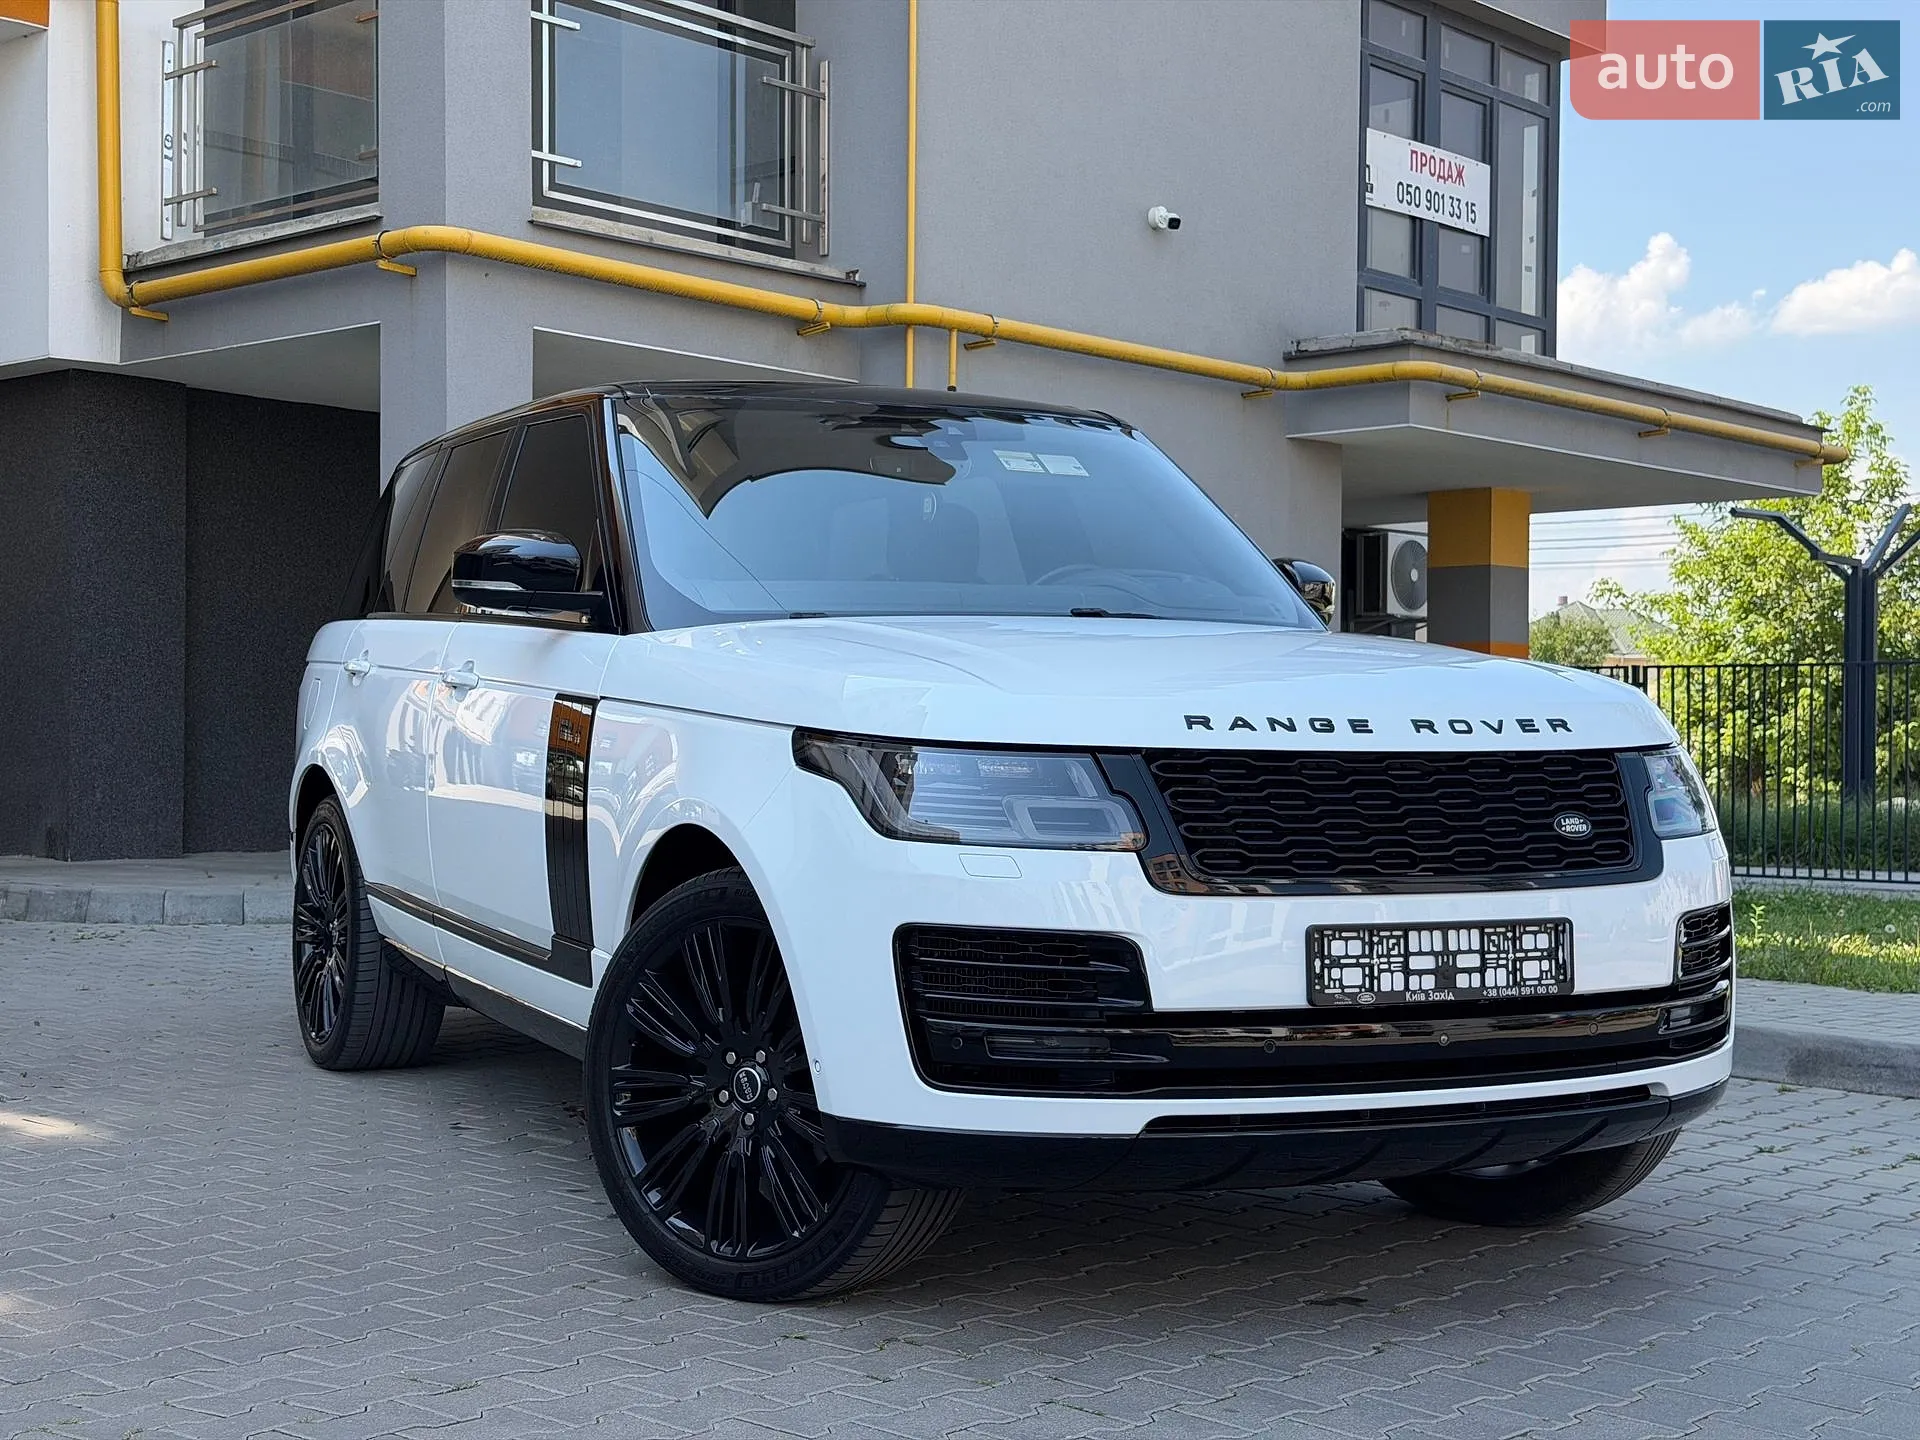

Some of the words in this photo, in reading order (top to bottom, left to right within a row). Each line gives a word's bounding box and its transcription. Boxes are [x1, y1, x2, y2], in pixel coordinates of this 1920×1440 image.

[1410, 149, 1465, 187] ПРОДАЖ
[1397, 181, 1421, 208] 050
[1425, 189, 1445, 215] 901
[1449, 196, 1462, 220] 33
[1465, 200, 1477, 224] 15
[1183, 714, 1374, 734] RANGE
[1410, 718, 1574, 735] ROVER
[1561, 817, 1580, 825] LAND
[1565, 823, 1587, 832] ROVER
[1482, 988, 1498, 997] +38
[1499, 987, 1519, 998] (044)
[1520, 986, 1535, 995] 591
[1537, 986, 1547, 994] 00
[1548, 985, 1558, 994] 00
